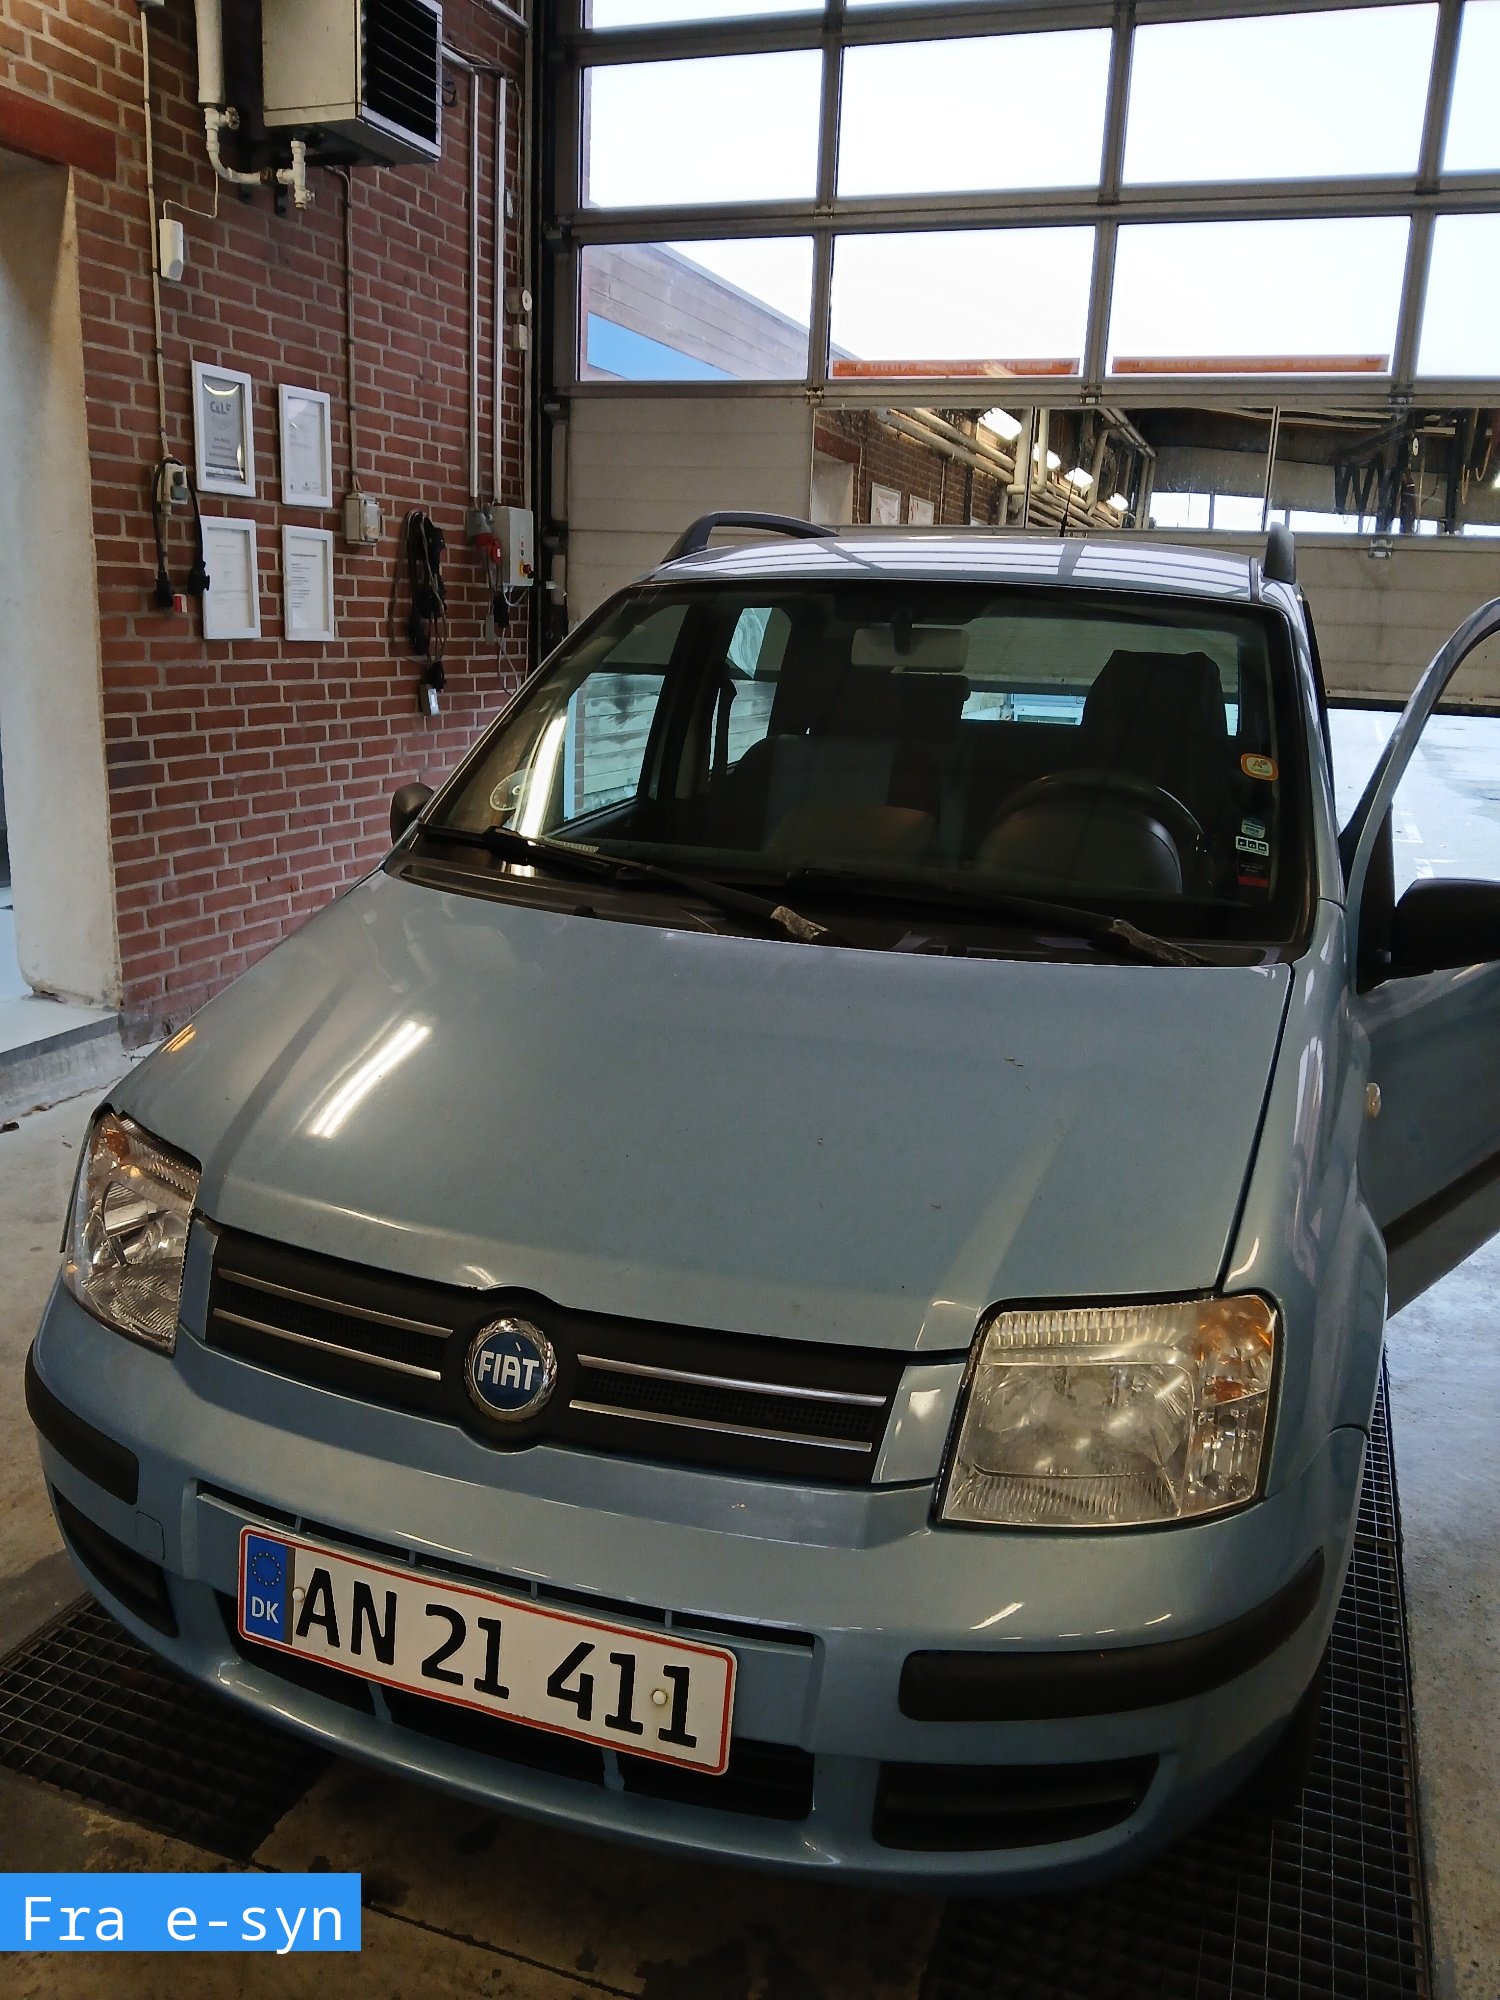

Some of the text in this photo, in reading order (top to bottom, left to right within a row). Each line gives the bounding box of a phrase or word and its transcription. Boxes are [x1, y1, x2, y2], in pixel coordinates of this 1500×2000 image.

[477, 1349, 540, 1391] FIAT
[250, 1595, 280, 1625] DK
[295, 1567, 698, 1749] AN 21 411
